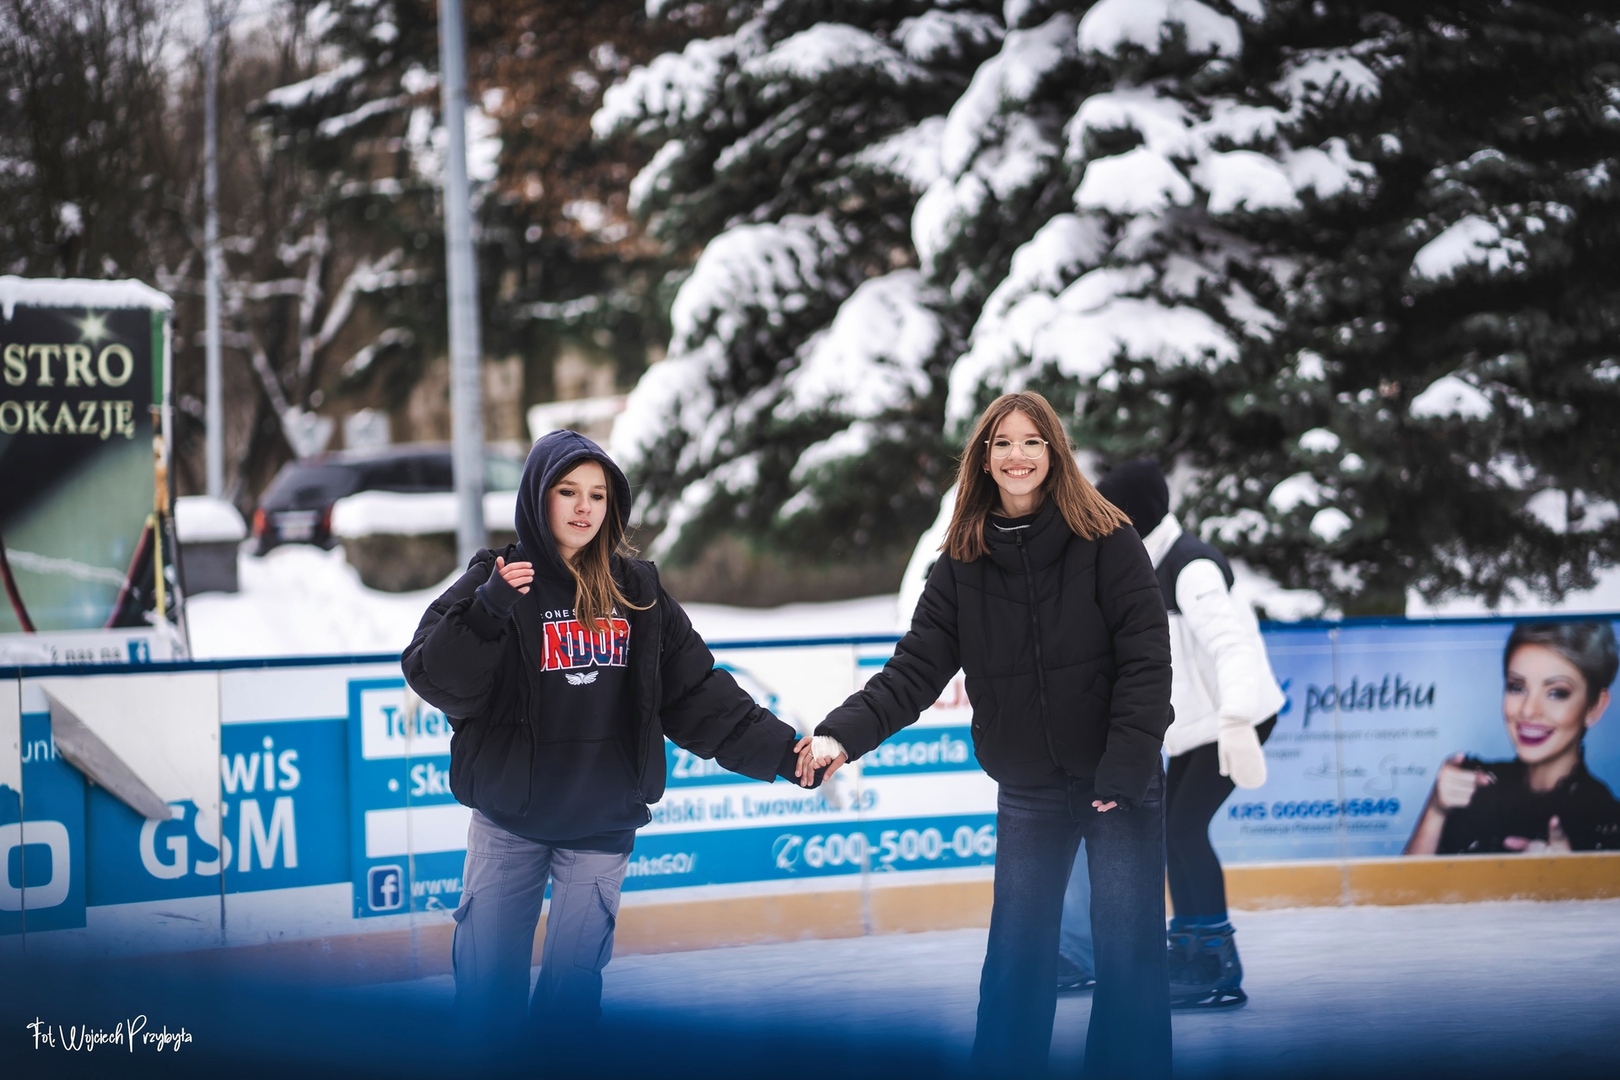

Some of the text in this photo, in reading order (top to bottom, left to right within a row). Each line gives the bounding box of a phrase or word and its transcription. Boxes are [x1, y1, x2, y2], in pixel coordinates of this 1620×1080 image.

[540, 617, 631, 672] NDOR
[1303, 672, 1438, 728] podatku
[652, 797, 707, 824] elski
[709, 794, 739, 820] ul.
[1228, 801, 1268, 820] KRS
[139, 796, 299, 880] GSM
